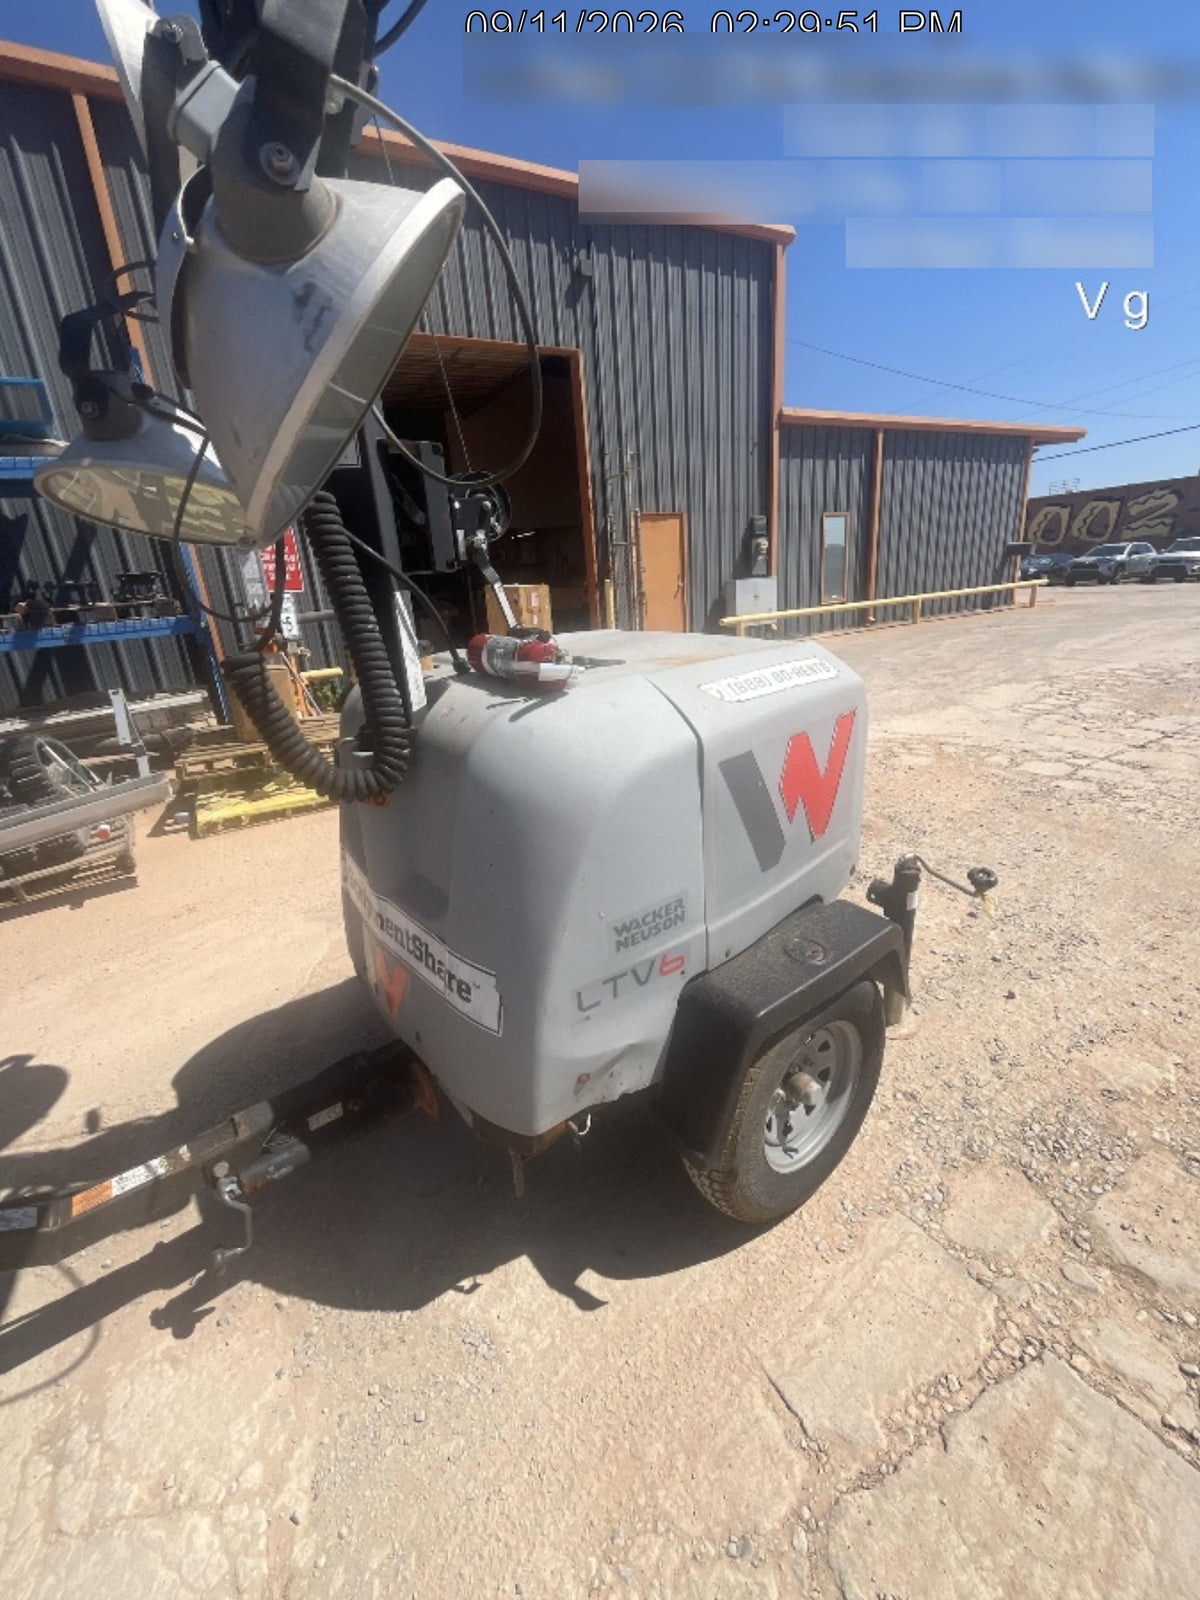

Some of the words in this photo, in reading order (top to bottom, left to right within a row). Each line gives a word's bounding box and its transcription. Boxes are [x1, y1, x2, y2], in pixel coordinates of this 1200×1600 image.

[613, 897, 685, 938] WACKER
[615, 910, 685, 954] NEUSON
[576, 954, 686, 1012] LTV6
